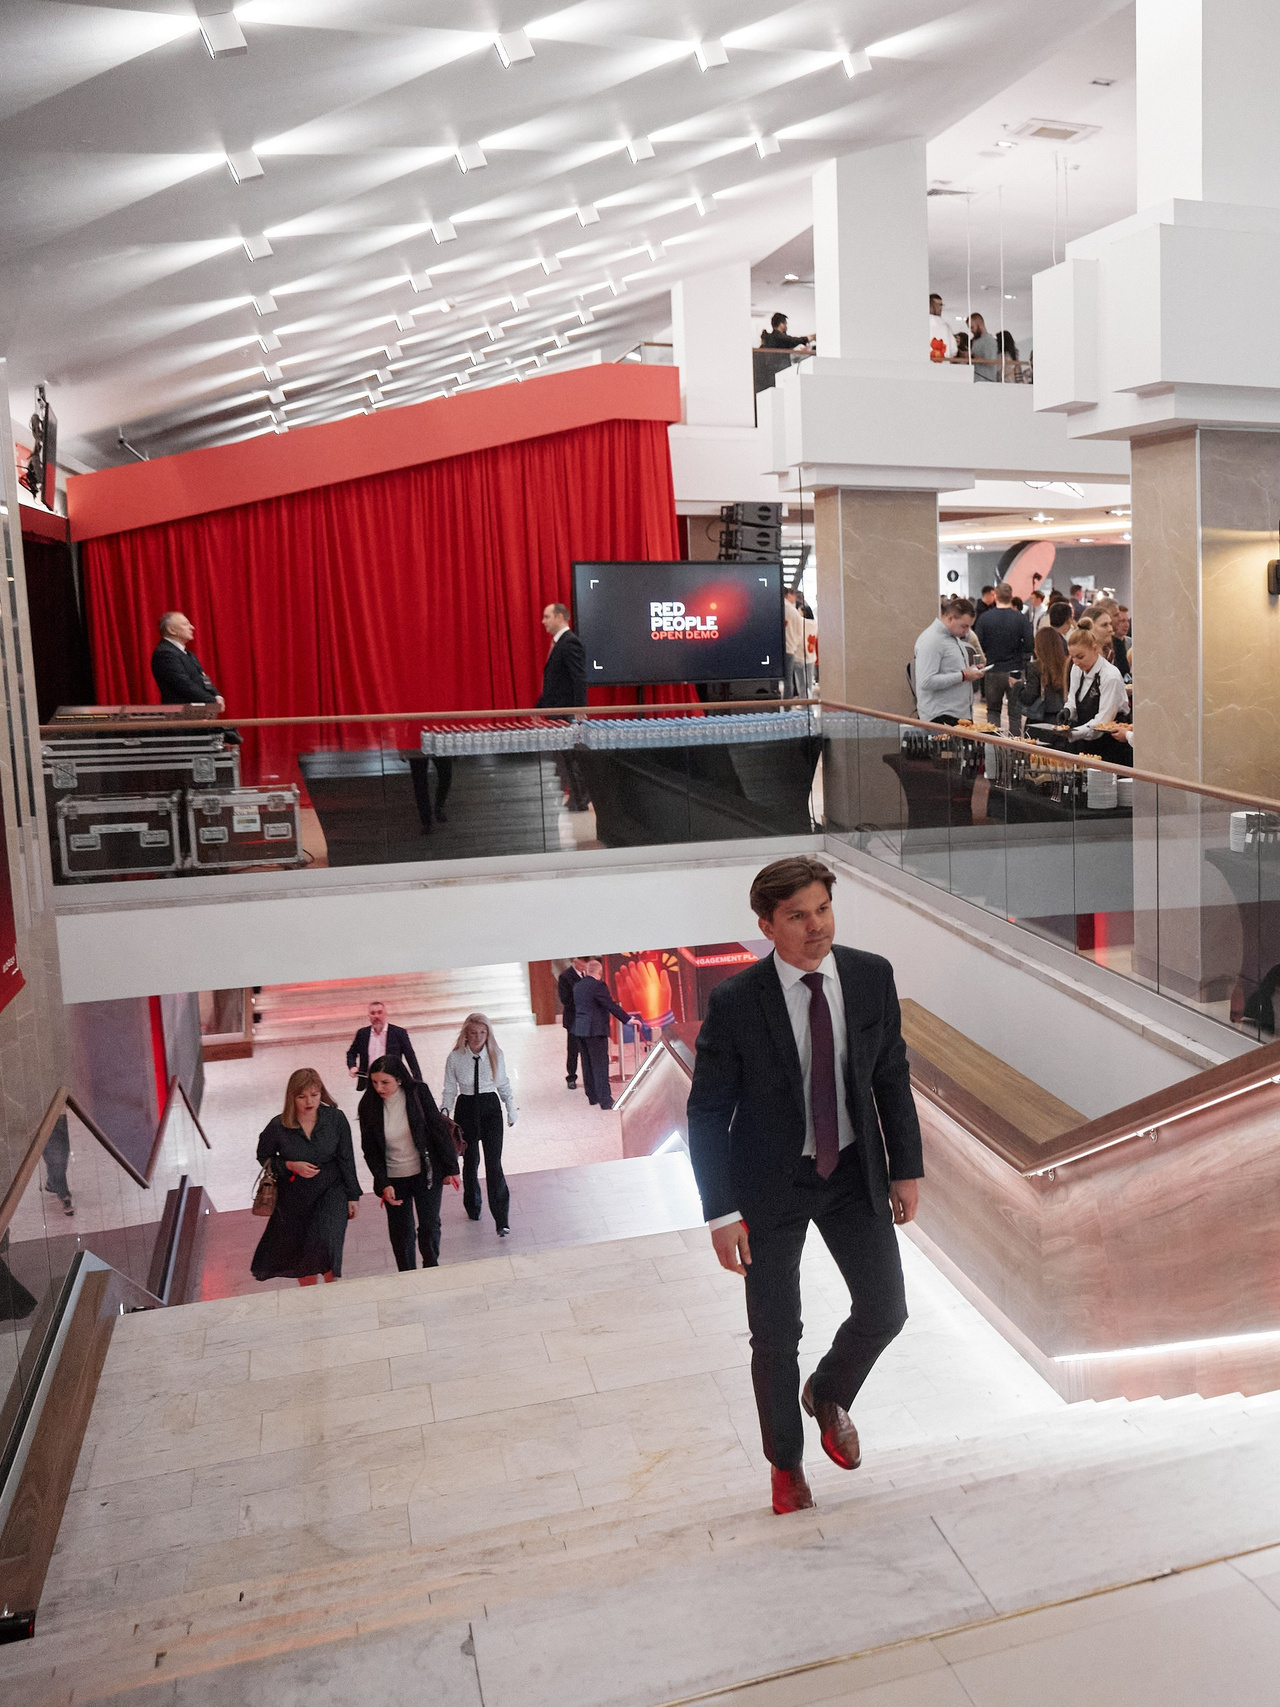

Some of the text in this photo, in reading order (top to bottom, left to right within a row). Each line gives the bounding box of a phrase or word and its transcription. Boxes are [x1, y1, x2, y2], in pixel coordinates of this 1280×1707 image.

[650, 602, 685, 616] RED
[651, 616, 718, 631] PEOPLE
[651, 630, 719, 640] OPEN DEMO
